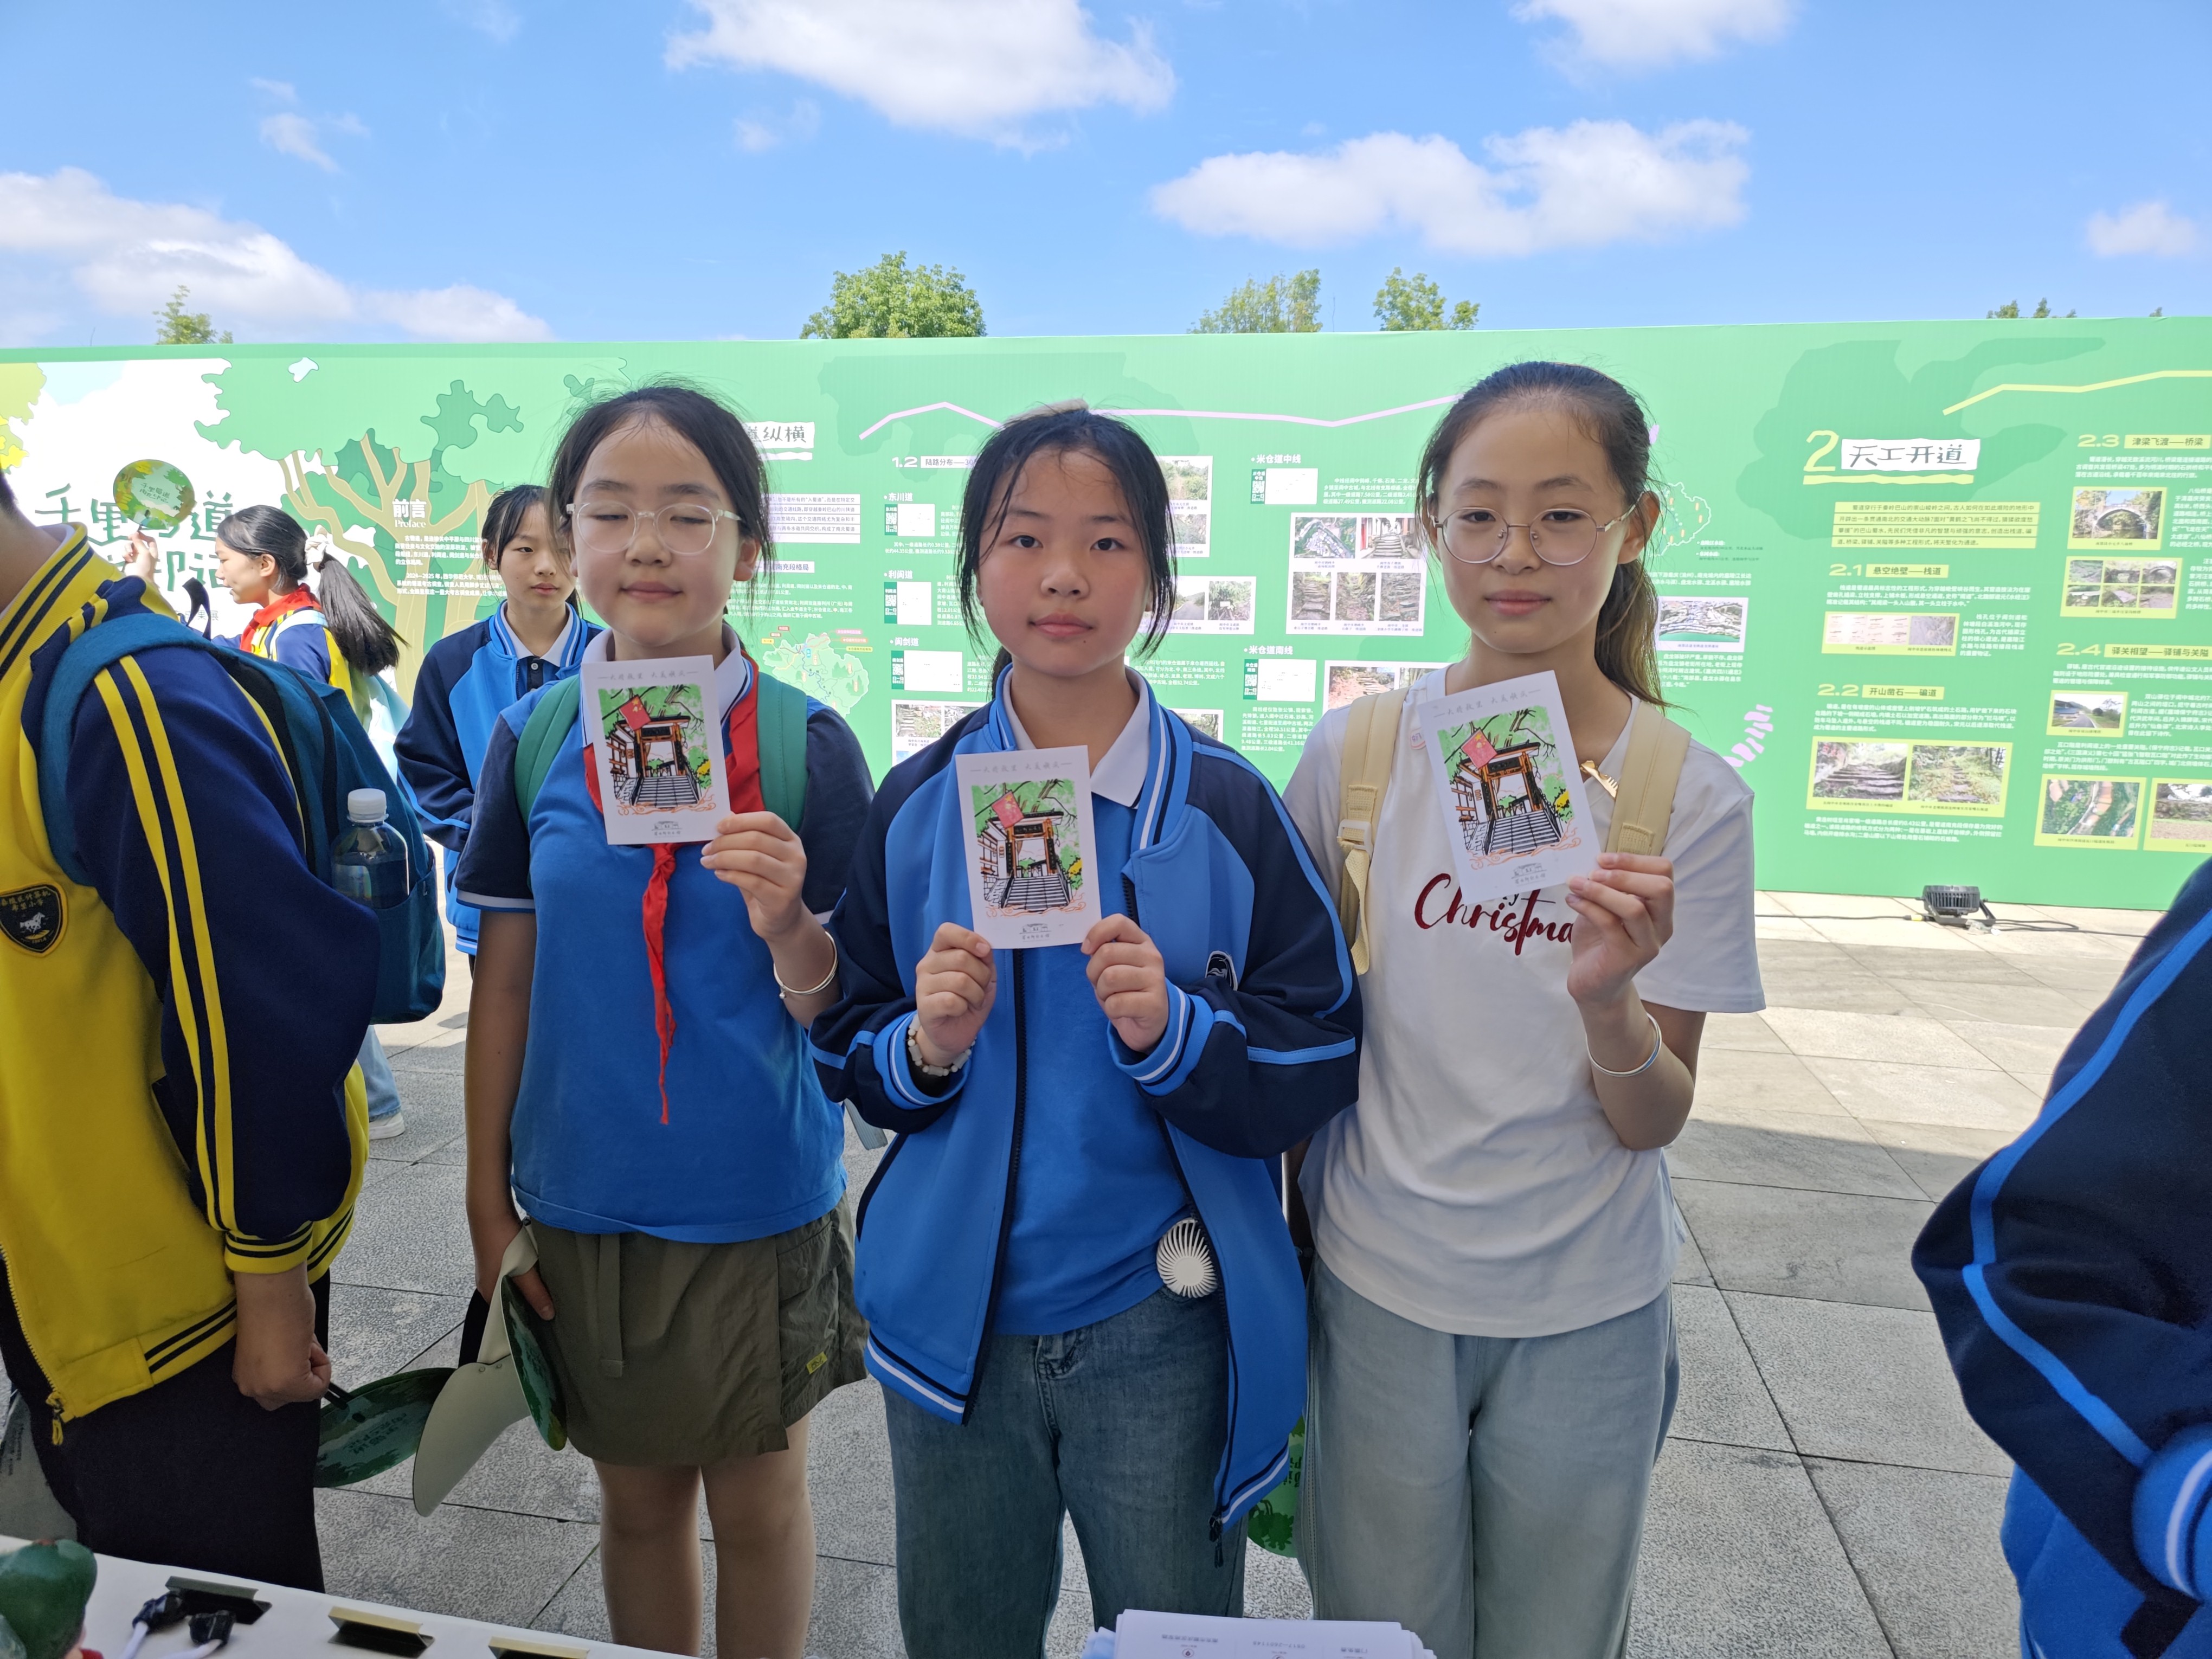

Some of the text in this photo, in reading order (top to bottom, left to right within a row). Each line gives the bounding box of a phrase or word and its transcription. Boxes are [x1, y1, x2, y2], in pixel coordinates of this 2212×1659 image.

[2078, 434, 2203, 448] 2.3 津梁飞渡——桥梁
[1803, 430, 1966, 472] 2 天工开道
[892, 456, 918, 468] 1.2
[1256, 454, 1301, 464] 米仓道中线
[889, 493, 913, 501] 东川道
[35, 483, 233, 546] 千里道
[392, 499, 427, 518] 前言
[889, 570, 913, 579] 利阆道
[1829, 564, 1941, 576] 2.1 悬空绝壁——栈道
[895, 638, 919, 646] 阆剑道
[1249, 645, 1293, 655] 米仓道南线
[2056, 643, 2101, 655] 2.4
[1817, 684, 1937, 697] 2.2 开山凿石——碥道
